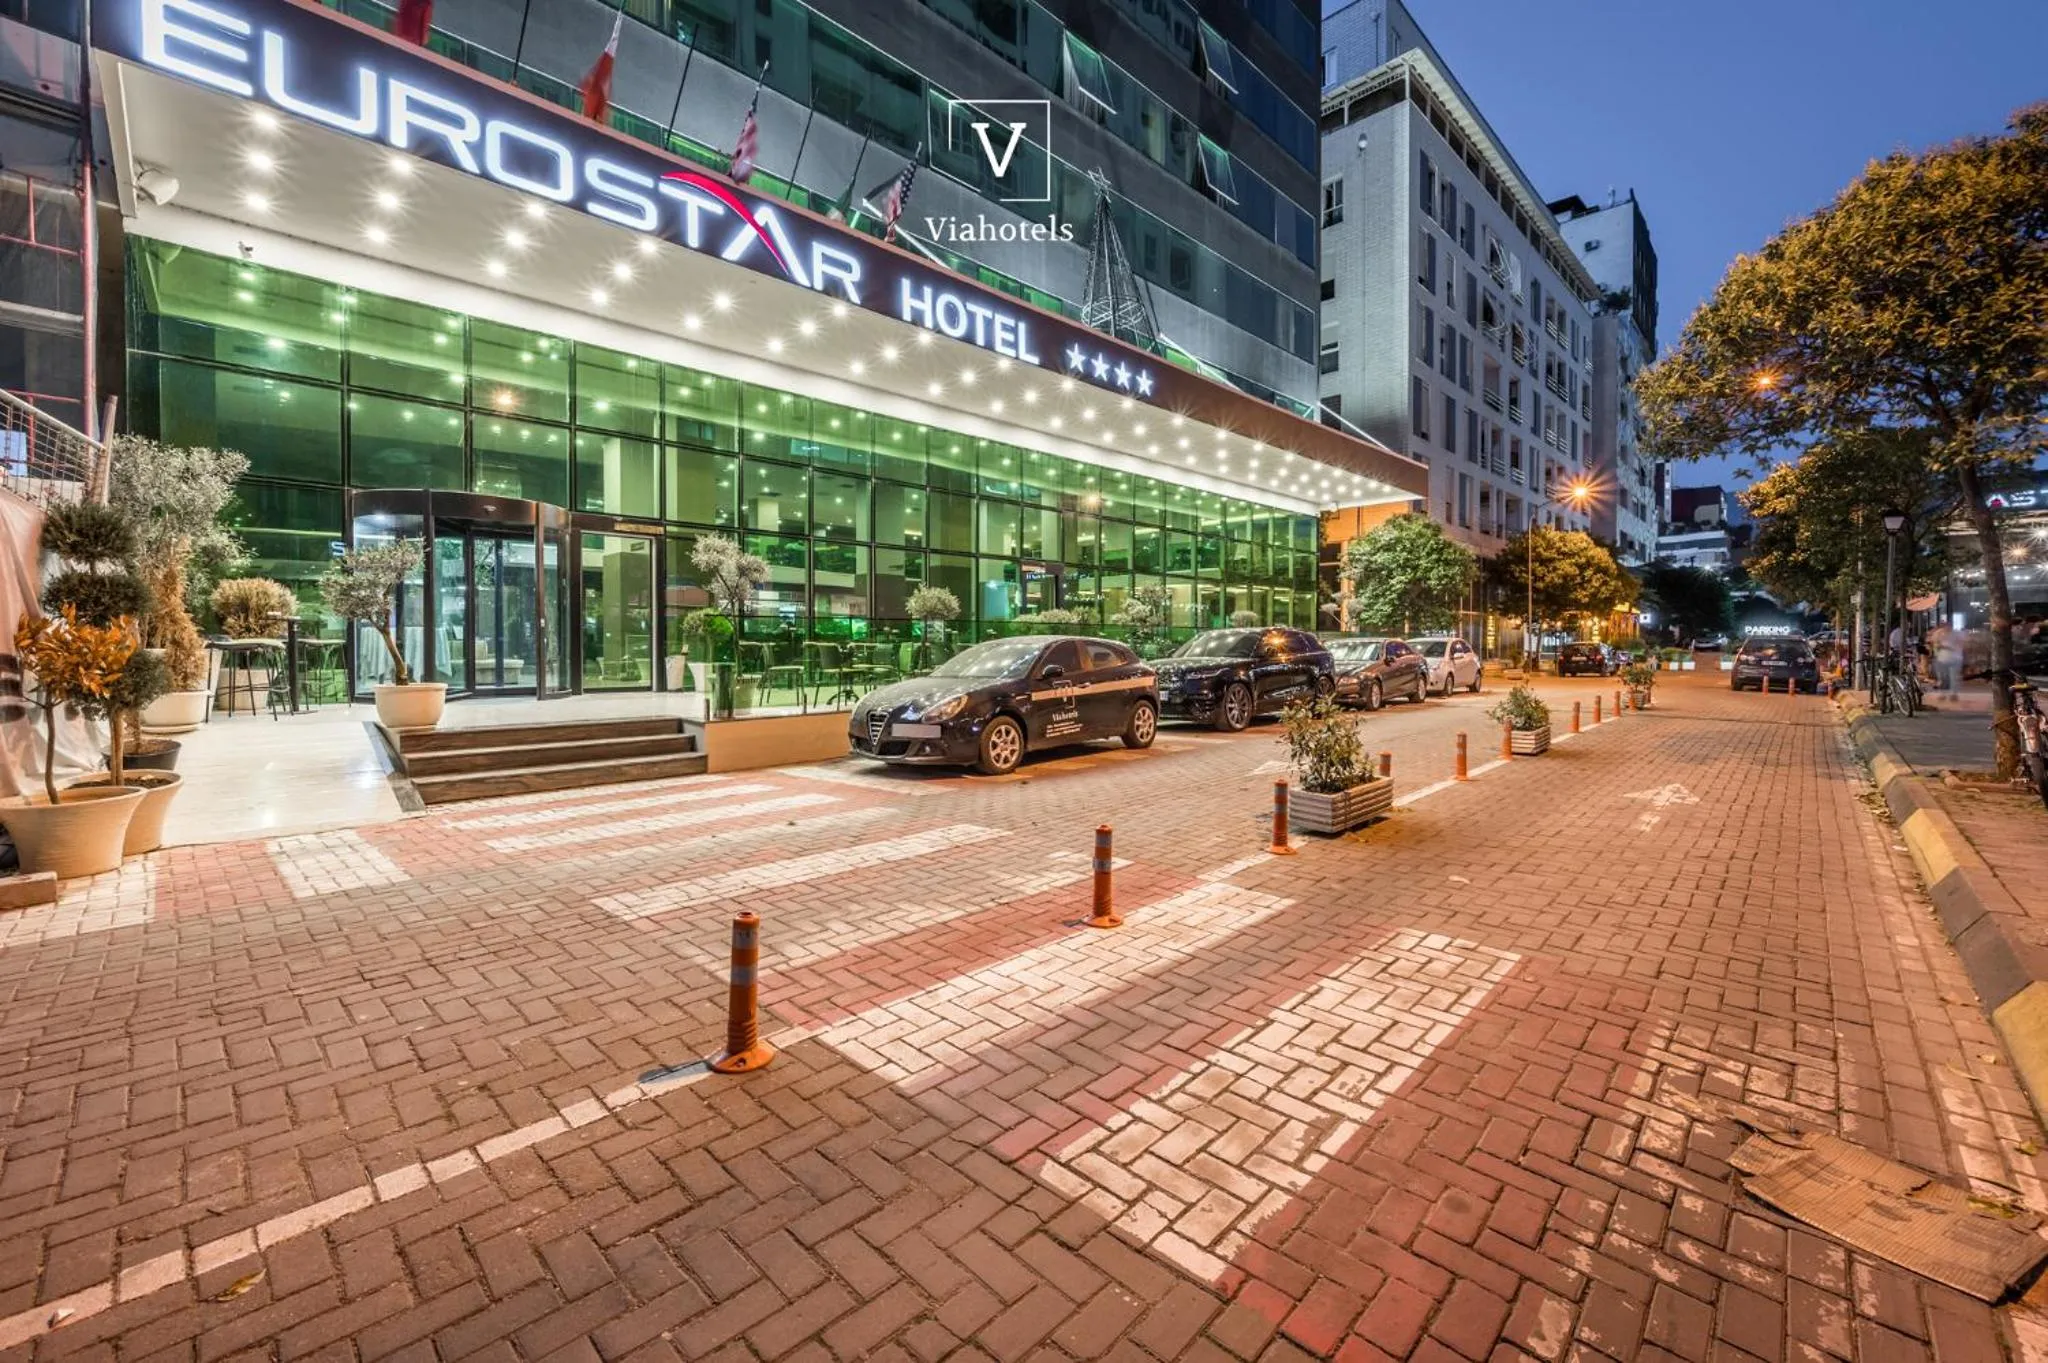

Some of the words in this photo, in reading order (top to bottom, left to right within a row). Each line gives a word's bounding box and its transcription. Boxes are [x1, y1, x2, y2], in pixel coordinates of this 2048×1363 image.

[141, 0, 861, 305] EUROSTAR
[901, 277, 1040, 365] HOTEL
[1745, 625, 1791, 636] PARKING
